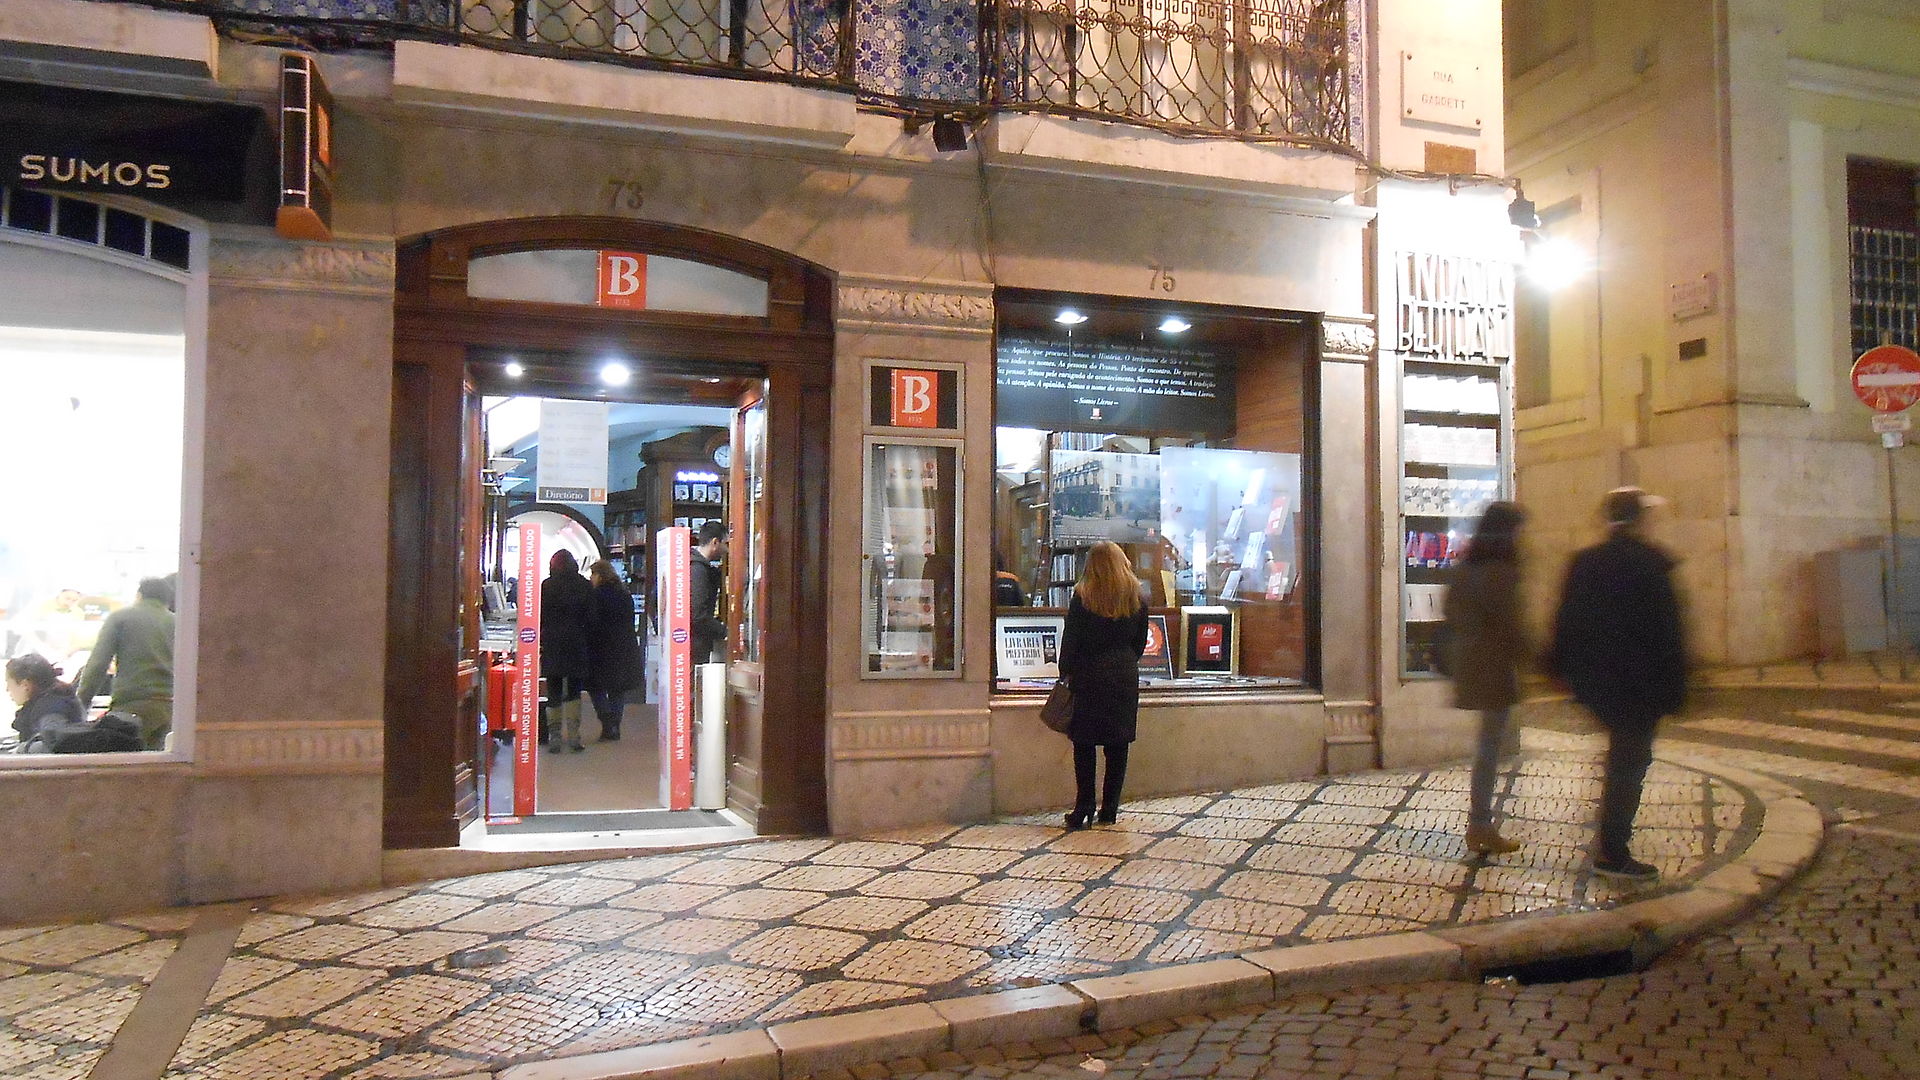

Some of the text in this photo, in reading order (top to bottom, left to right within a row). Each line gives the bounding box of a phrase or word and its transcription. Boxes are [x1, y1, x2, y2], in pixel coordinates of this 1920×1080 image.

[1433, 70, 1455, 84] RUA
[1421, 93, 1466, 111] GARRETT
[21, 154, 171, 189] SUMOS
[608, 180, 643, 210] 73
[608, 256, 640, 296] B
[1148, 264, 1176, 292] 75
[1397, 301, 1510, 362] BERTRAND
[1011, 346, 1031, 356] Aquilo
[1027, 368, 1045, 377] Temos
[1044, 369, 1058, 378] pele
[1086, 372, 1094, 380] de
[1136, 376, 1154, 384] Somos
[1159, 379, 1170, 387] que
[1187, 379, 1193, 387] A
[1057, 360, 1066, 368] As
[1120, 364, 1138, 372] Ponto
[1138, 365, 1146, 373] de
[1173, 367, 1182, 375] De
[1182, 370, 1198, 378] quem
[902, 376, 931, 413] B
[1005, 377, 1011, 385] A
[1036, 379, 1042, 388] A
[1066, 381, 1085, 390] Somos
[1136, 386, 1143, 394] A
[1179, 388, 1198, 397] Somos
[1197, 390, 1217, 399] Livros.
[1078, 397, 1114, 406] Somos Livros
[526, 529, 535, 568] SOLNADO
[675, 532, 684, 570] SOLNADO
[524, 570, 535, 617] ALEXANDRA
[676, 572, 685, 618] ALEXANDRA
[1005, 637, 1040, 649] LIVRARIA
[523, 653, 533, 667] VIA
[676, 653, 685, 666] VIA
[1006, 649, 1041, 659] PREFERIDA
[523, 667, 532, 678] TE
[676, 667, 685, 678] TE
[522, 678, 532, 696] NÃO
[675, 678, 685, 694] NÃO
[523, 696, 533, 713] QUE
[676, 694, 686, 712] QUE
[522, 713, 532, 736] ANOS
[676, 712, 685, 735] ANOS
[521, 737, 531, 752] MIL
[676, 735, 685, 749] MIL
[521, 752, 530, 763] HÁ
[675, 748, 685, 761] HÁ
